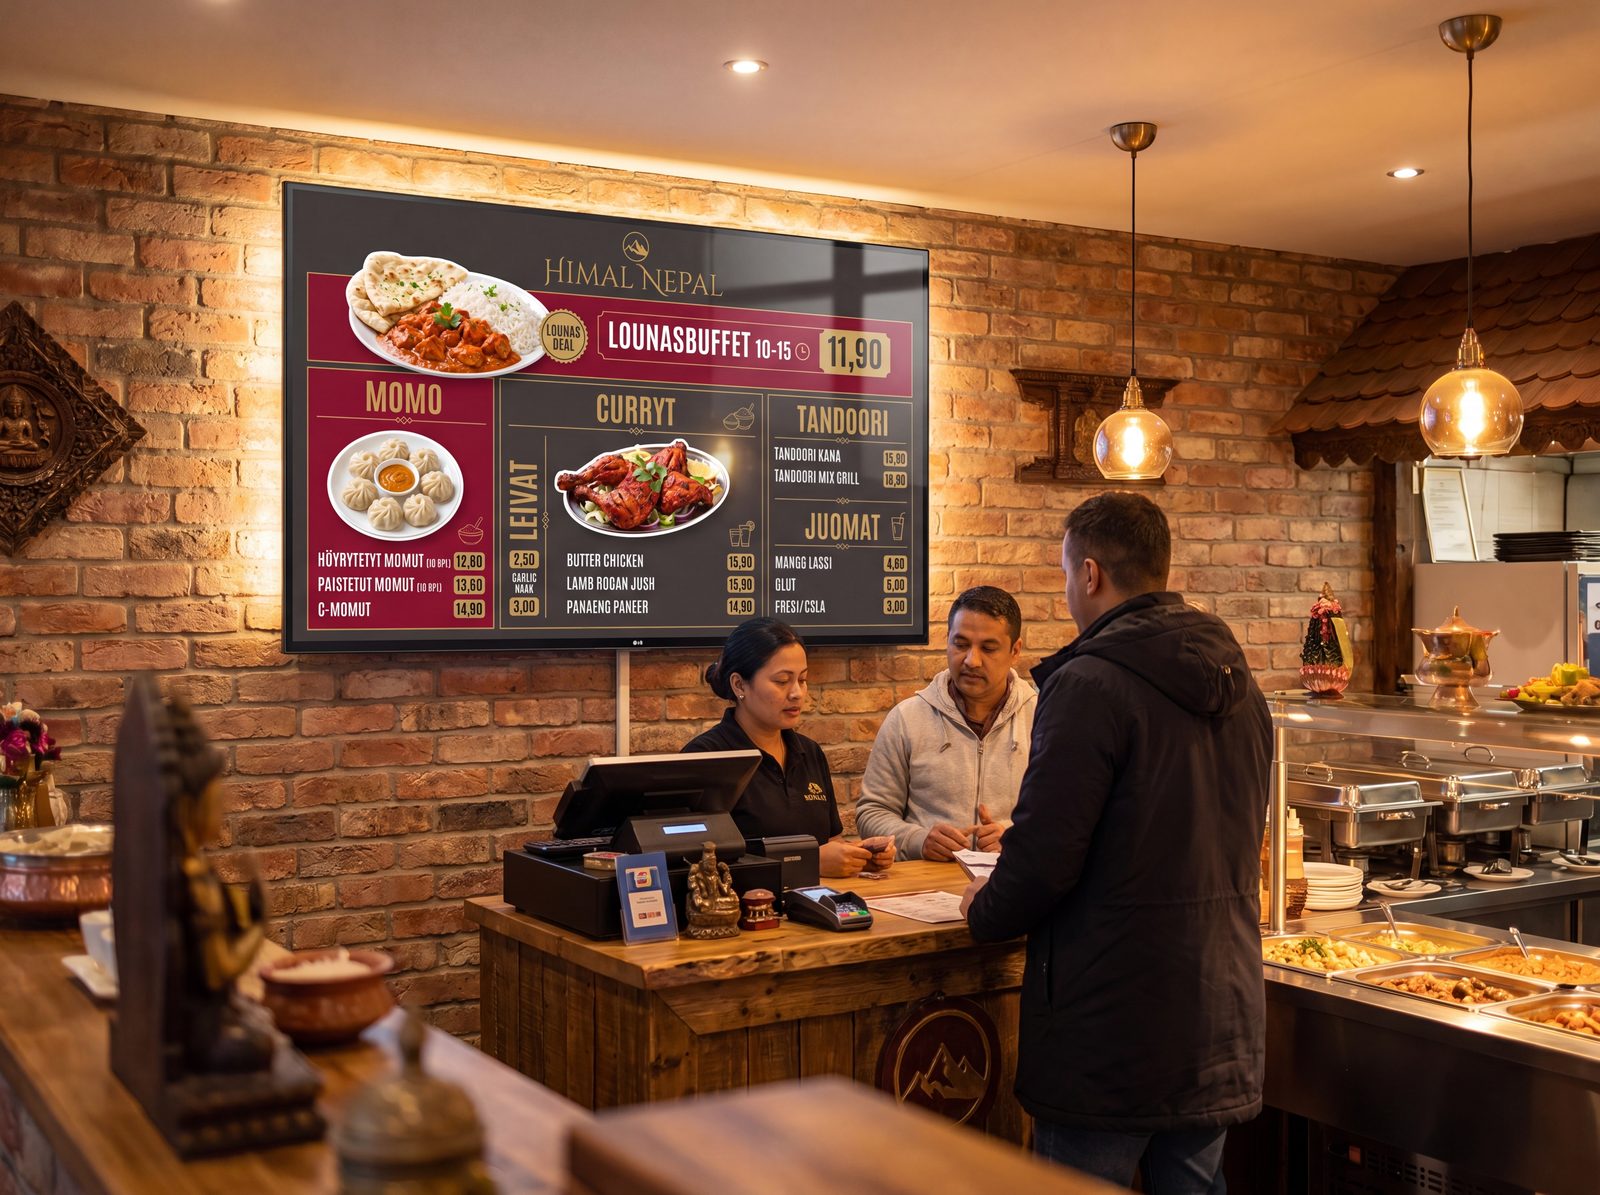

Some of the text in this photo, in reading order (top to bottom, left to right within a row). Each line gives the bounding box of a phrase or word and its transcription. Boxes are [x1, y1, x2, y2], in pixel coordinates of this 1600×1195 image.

[544, 256, 724, 297] HIMAL NEPAL
[546, 323, 581, 339] LOUNAS
[553, 337, 575, 352] DEAL
[608, 321, 792, 361] LOUNASBUFFET 10-15
[827, 335, 882, 373] 11,90
[365, 380, 443, 415] MOMO
[596, 393, 676, 427] CURRYT
[797, 405, 889, 437] TANDOORI
[774, 446, 842, 463] TANDOORI KANA
[774, 468, 860, 486] TANDOORI MIX GRILL
[509, 460, 538, 540] LEIVAT
[804, 512, 881, 541] JUOMAT
[317, 549, 382, 568] HÖYRYTETYT
[384, 553, 424, 568] MOMUT
[513, 552, 535, 568] 2,50
[566, 553, 644, 568] BUTTER CHICKEN
[728, 556, 753, 570] 15,90
[808, 556, 833, 570] LASSI
[886, 557, 905, 571] 4,60
[317, 576, 372, 592] PAISTETUT
[374, 577, 415, 592] MOMUT
[456, 578, 483, 594] 13,60
[511, 573, 537, 583] GARLIC
[566, 576, 594, 591] LAMB
[630, 577, 655, 591] JUSH
[728, 578, 753, 593] 15,90
[775, 577, 797, 592] GLUT
[514, 584, 534, 595] NAAK
[317, 601, 372, 617] C-MOMUT
[456, 602, 483, 618] 14,90
[513, 599, 535, 615] 3,00
[566, 600, 649, 614] PANAENG PANEER
[728, 600, 753, 616] 14,90
[886, 600, 905, 614] 3,00
